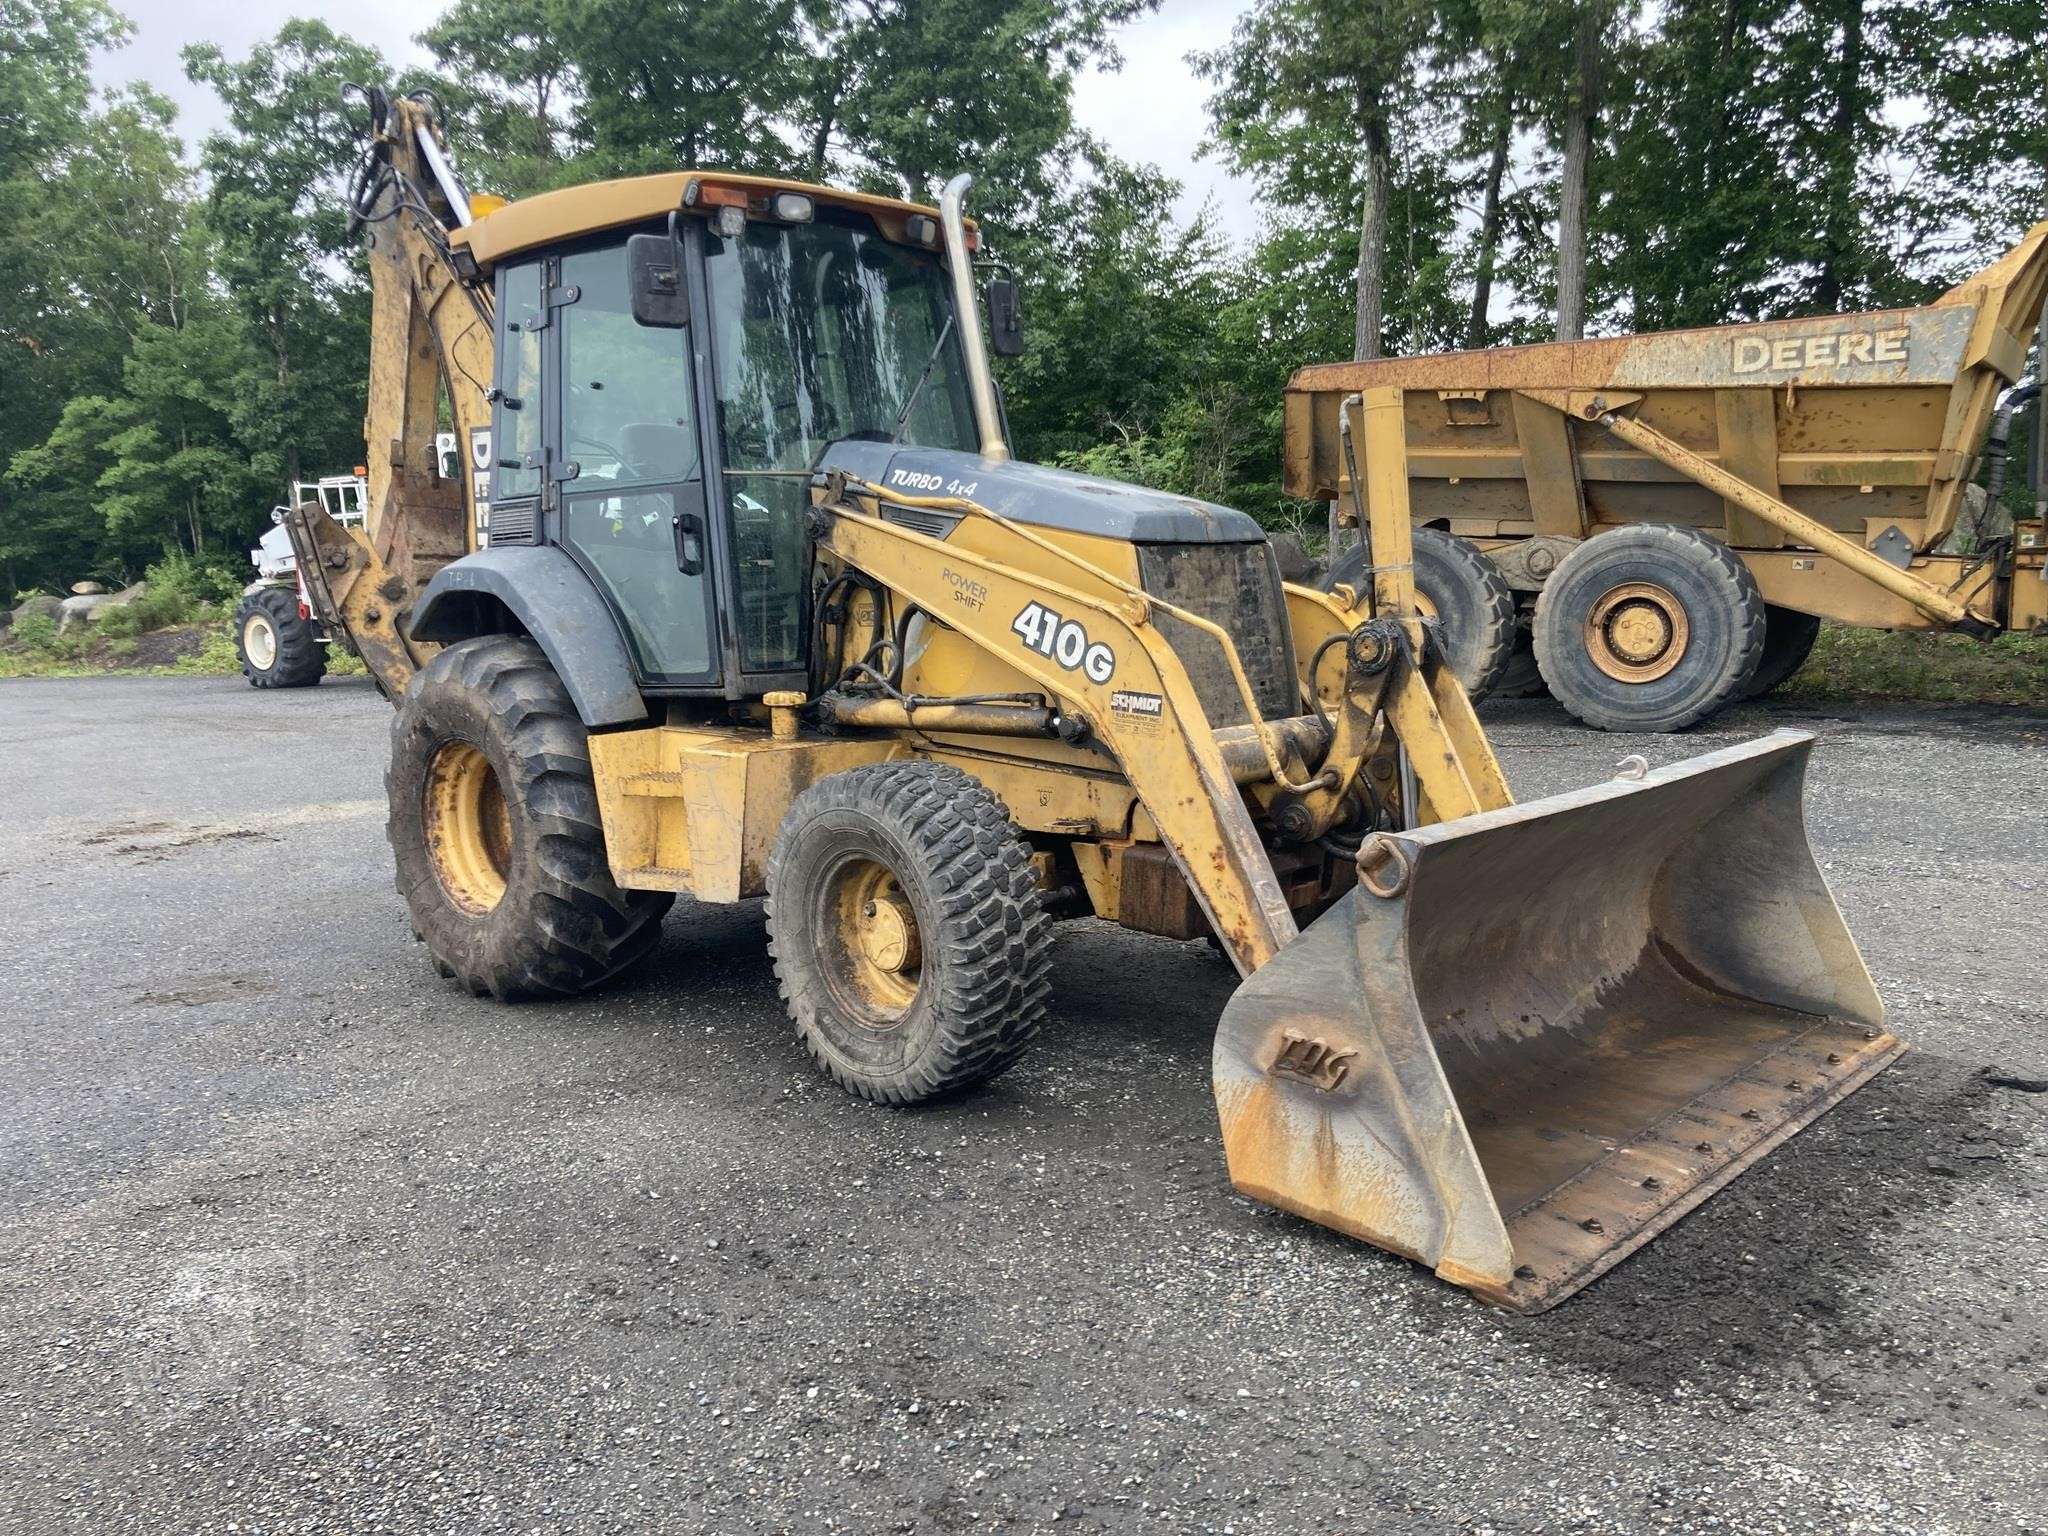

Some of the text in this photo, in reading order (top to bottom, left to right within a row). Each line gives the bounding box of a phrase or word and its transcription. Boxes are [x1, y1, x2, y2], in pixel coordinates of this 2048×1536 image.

[1733, 328, 1910, 373] DEERE
[891, 469, 979, 497] TURBO 4x4
[942, 567, 988, 602] POWER
[953, 590, 985, 613] SHIFT
[1012, 602, 1114, 684] 410G
[1110, 693, 1162, 712] SCHMIDT
